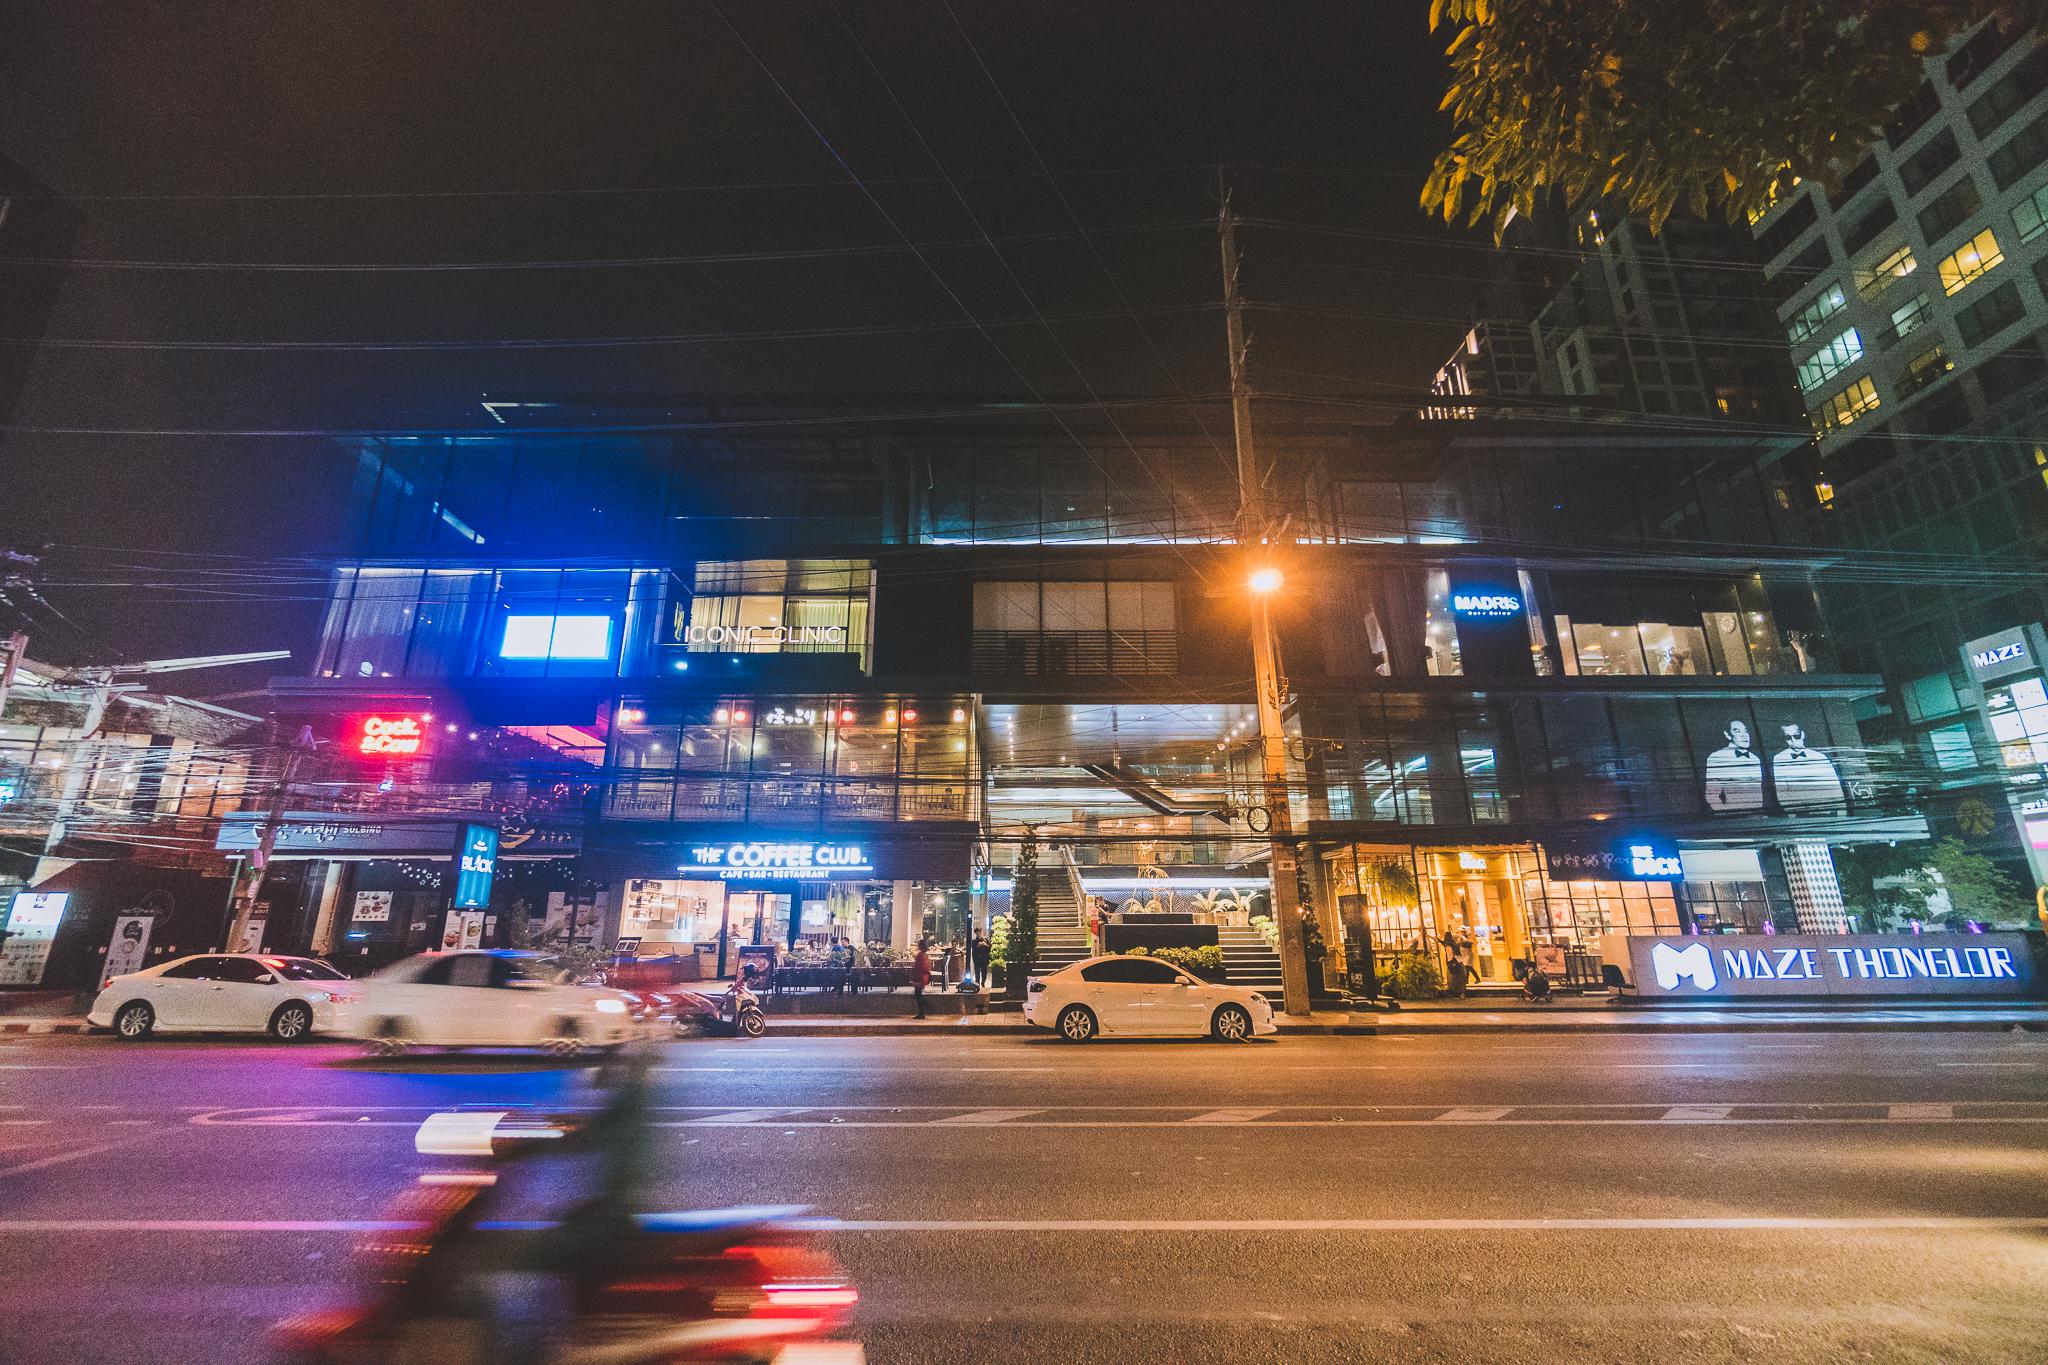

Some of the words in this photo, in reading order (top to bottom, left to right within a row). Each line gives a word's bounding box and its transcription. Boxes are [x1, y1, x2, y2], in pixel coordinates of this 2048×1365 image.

[1454, 596, 1520, 610] MADRIS
[684, 626, 762, 643] ICONIC
[771, 626, 842, 643] CLINIC
[1972, 642, 2025, 668] MAZE
[692, 847, 725, 864] THE
[727, 845, 814, 866] COFFEE
[1630, 845, 1654, 858] THE
[749, 870, 767, 879] BAR
[772, 870, 830, 879] RESTAURANT
[1723, 948, 1824, 979] MAZE
[1827, 947, 2018, 979] THONGLOR
